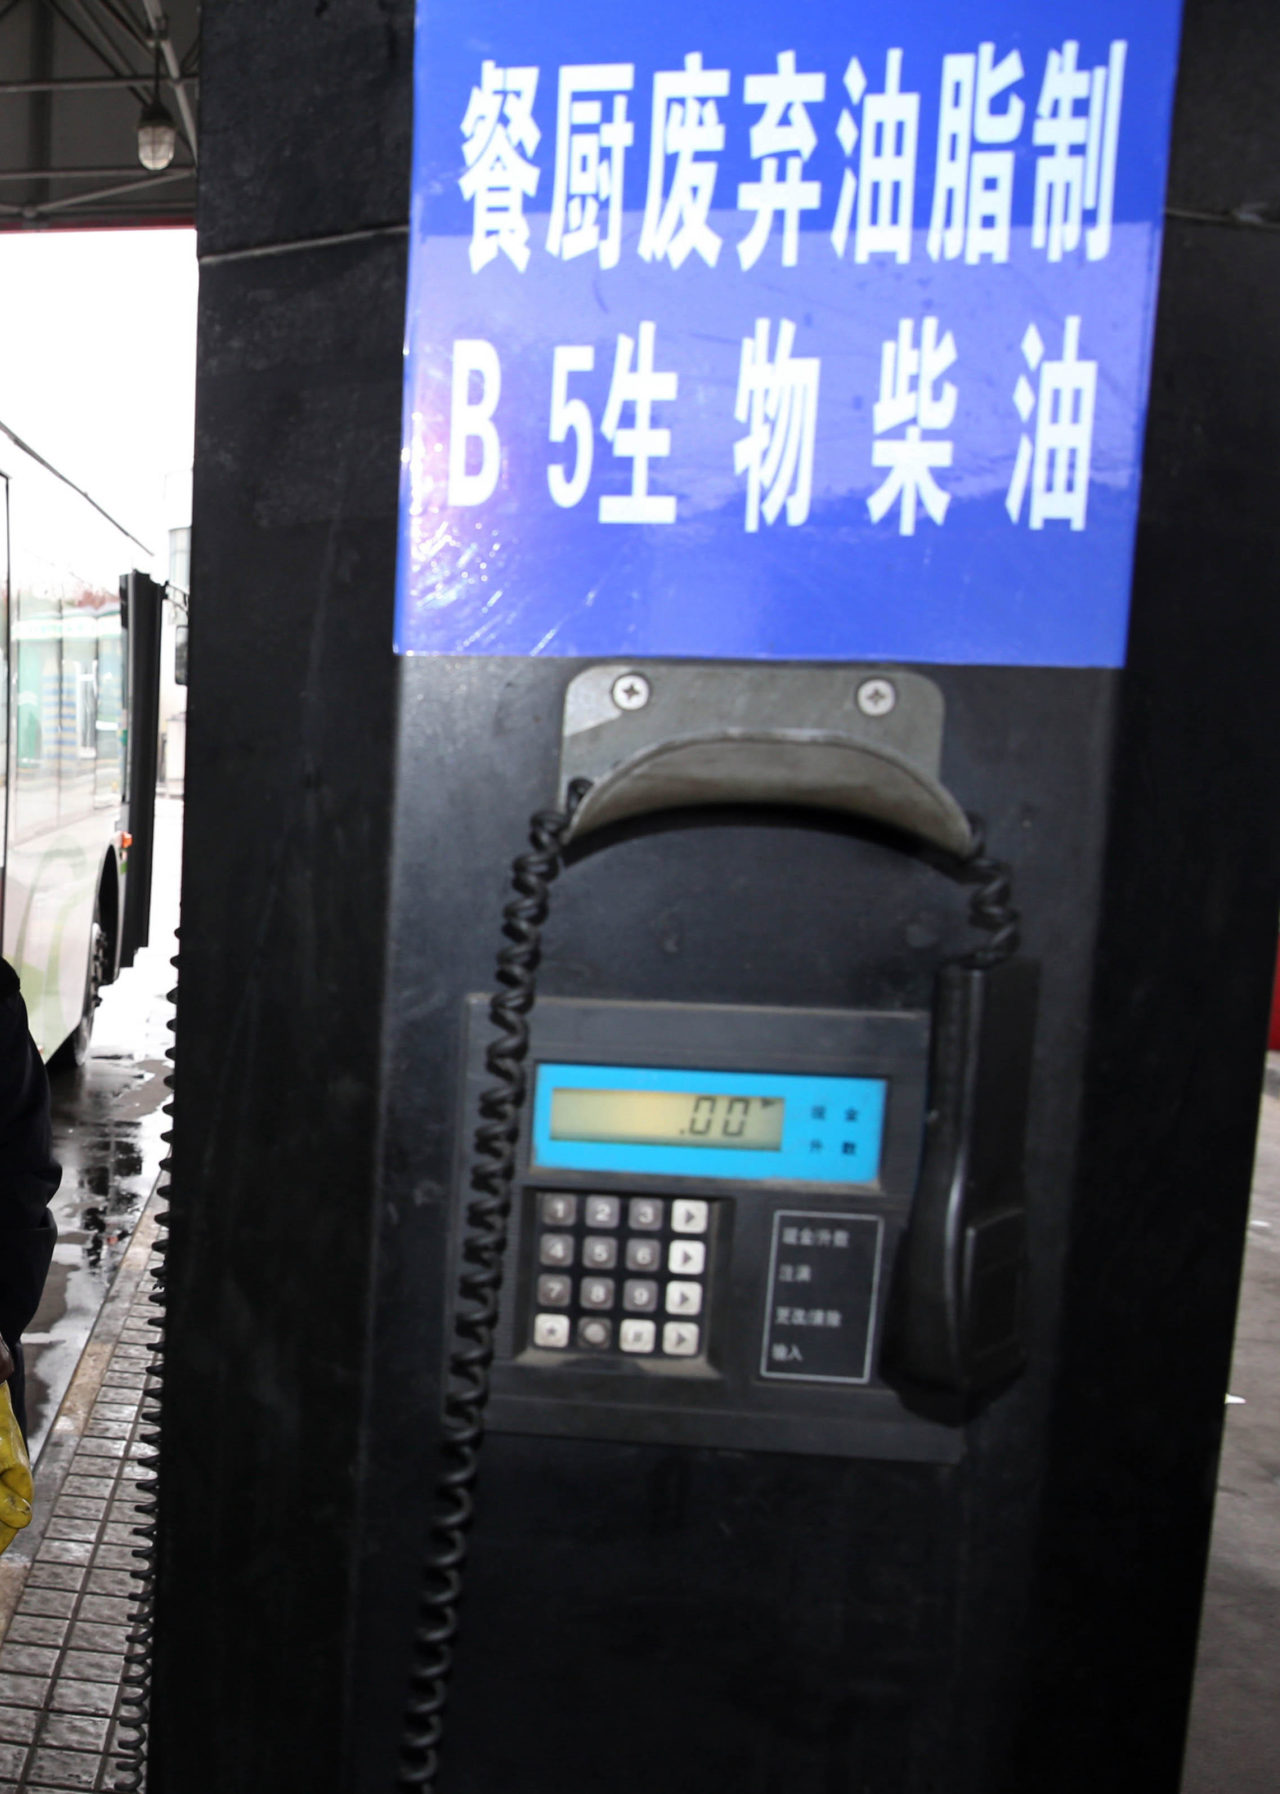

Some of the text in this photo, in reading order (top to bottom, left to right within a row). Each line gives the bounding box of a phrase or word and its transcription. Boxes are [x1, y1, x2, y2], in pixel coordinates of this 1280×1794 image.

[457, 39, 1129, 274] 餐厨废弃油脂制
[554, 1201, 654, 1224] 1 2 3
[549, 1242, 651, 1265] 4 5 6
[547, 1281, 649, 1305] 7 8 9
